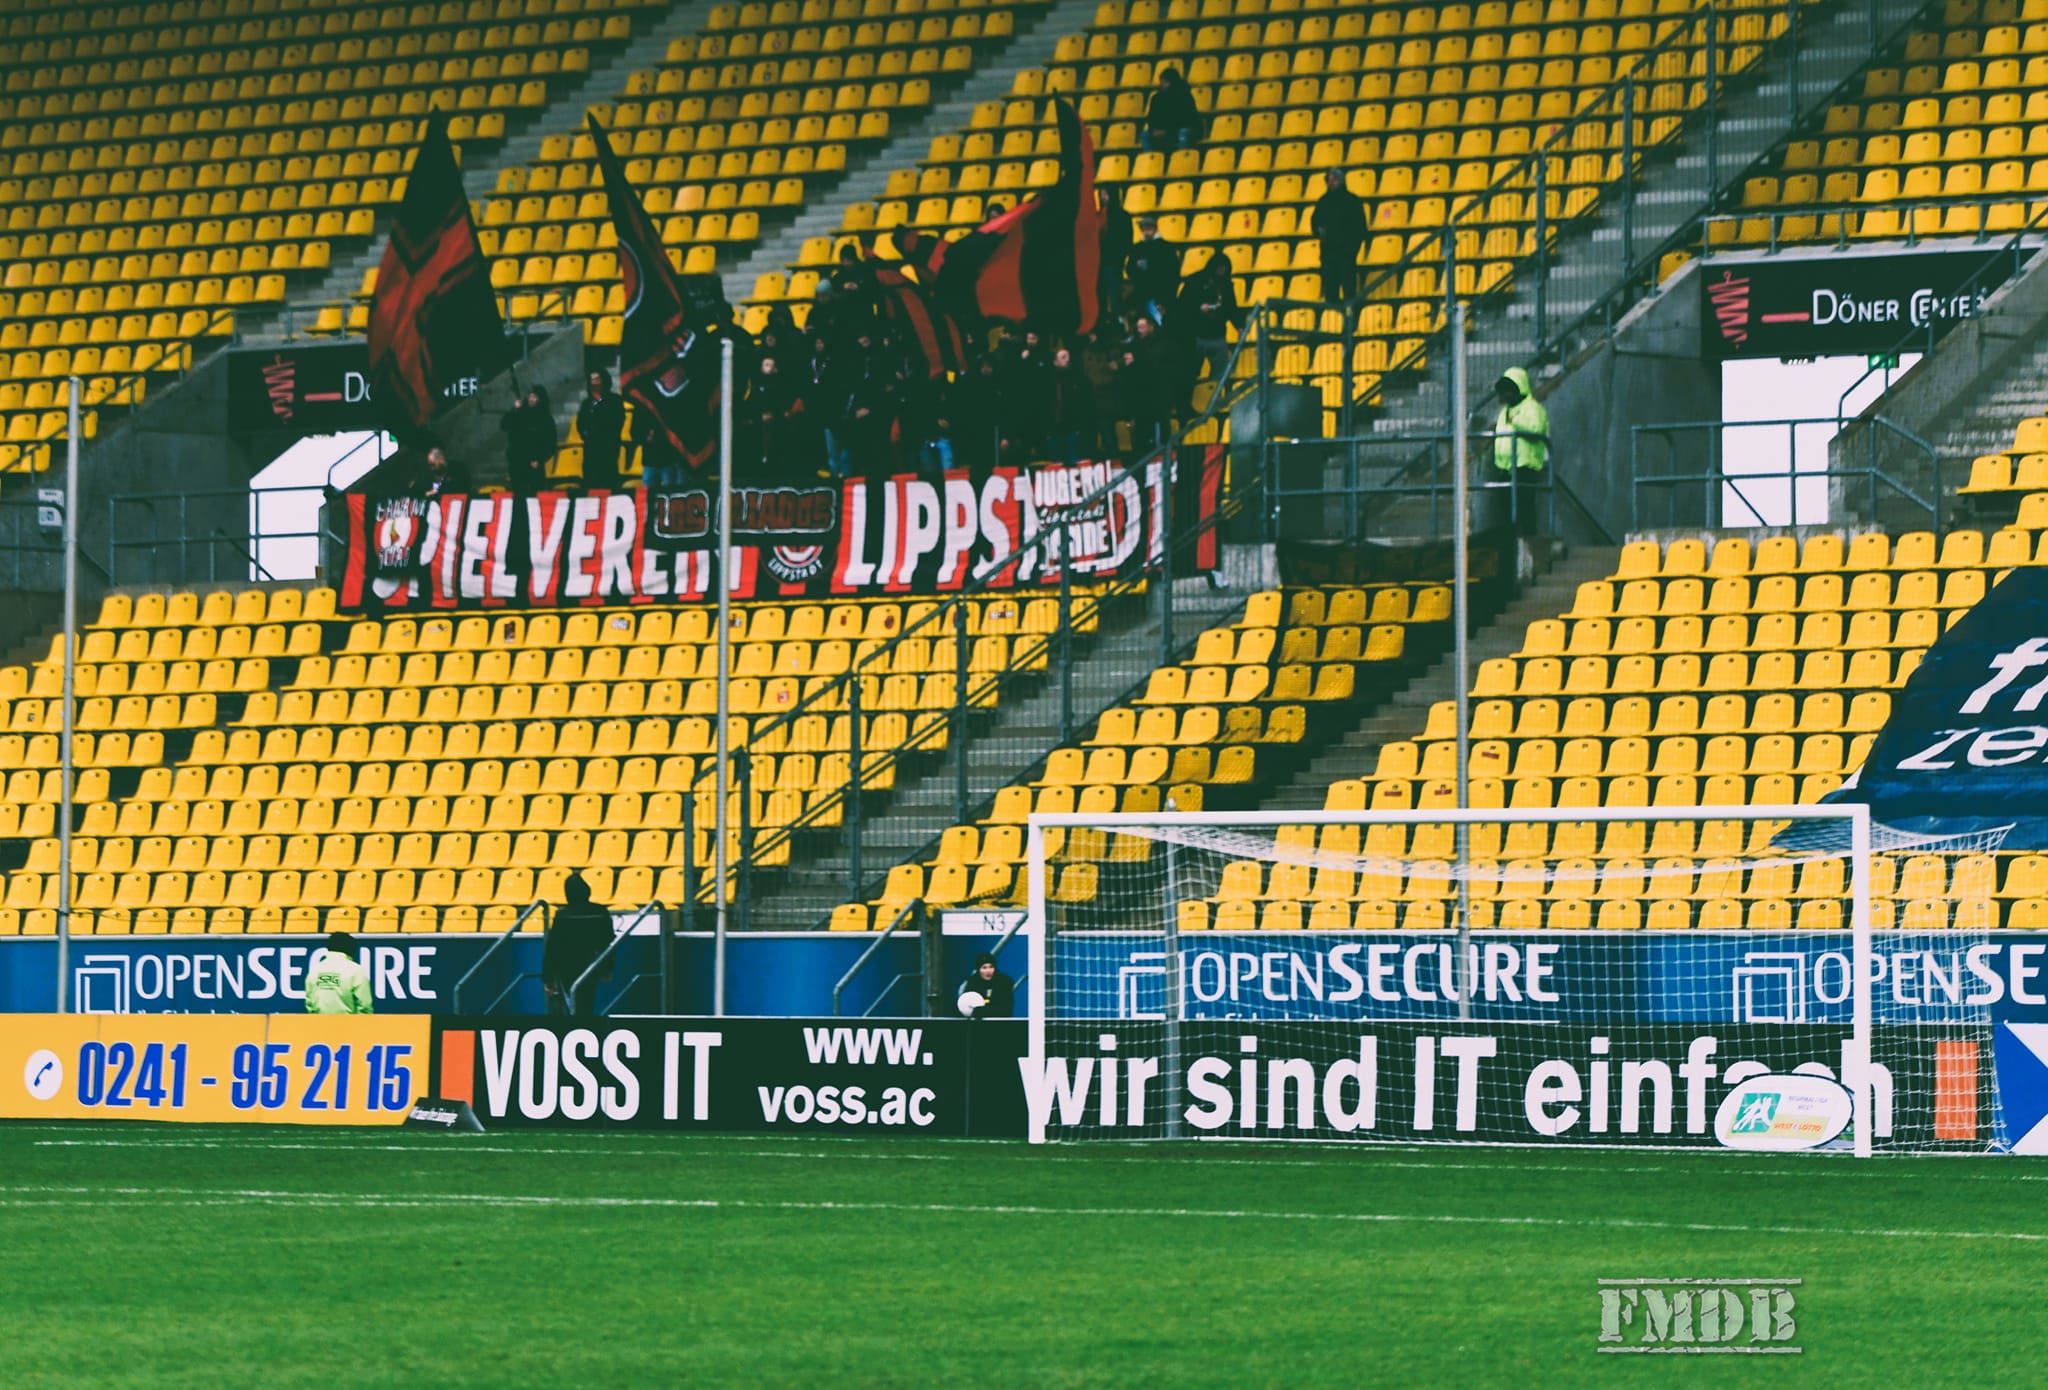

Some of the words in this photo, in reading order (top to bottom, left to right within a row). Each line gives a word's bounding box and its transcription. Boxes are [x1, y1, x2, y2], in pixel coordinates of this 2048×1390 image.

[1813, 288, 1899, 325] DÖNER
[843, 460, 1178, 587] LIPPSTDT
[983, 914, 1006, 932] N3
[1191, 943, 1560, 1003] OPENSECURE
[78, 1040, 188, 1109] 0241
[231, 1042, 290, 1110] 95
[301, 1043, 352, 1111] 21
[366, 1045, 413, 1112] 15
[481, 1029, 641, 1121] VOSS
[663, 1031, 723, 1121] IT
[803, 1027, 934, 1066] www.
[758, 1086, 936, 1126] voss.ac
[1018, 1034, 1158, 1127] wir
[1184, 1036, 1377, 1132] sind
[1413, 1036, 1497, 1132] IT
[1524, 1037, 1893, 1138] einfh
